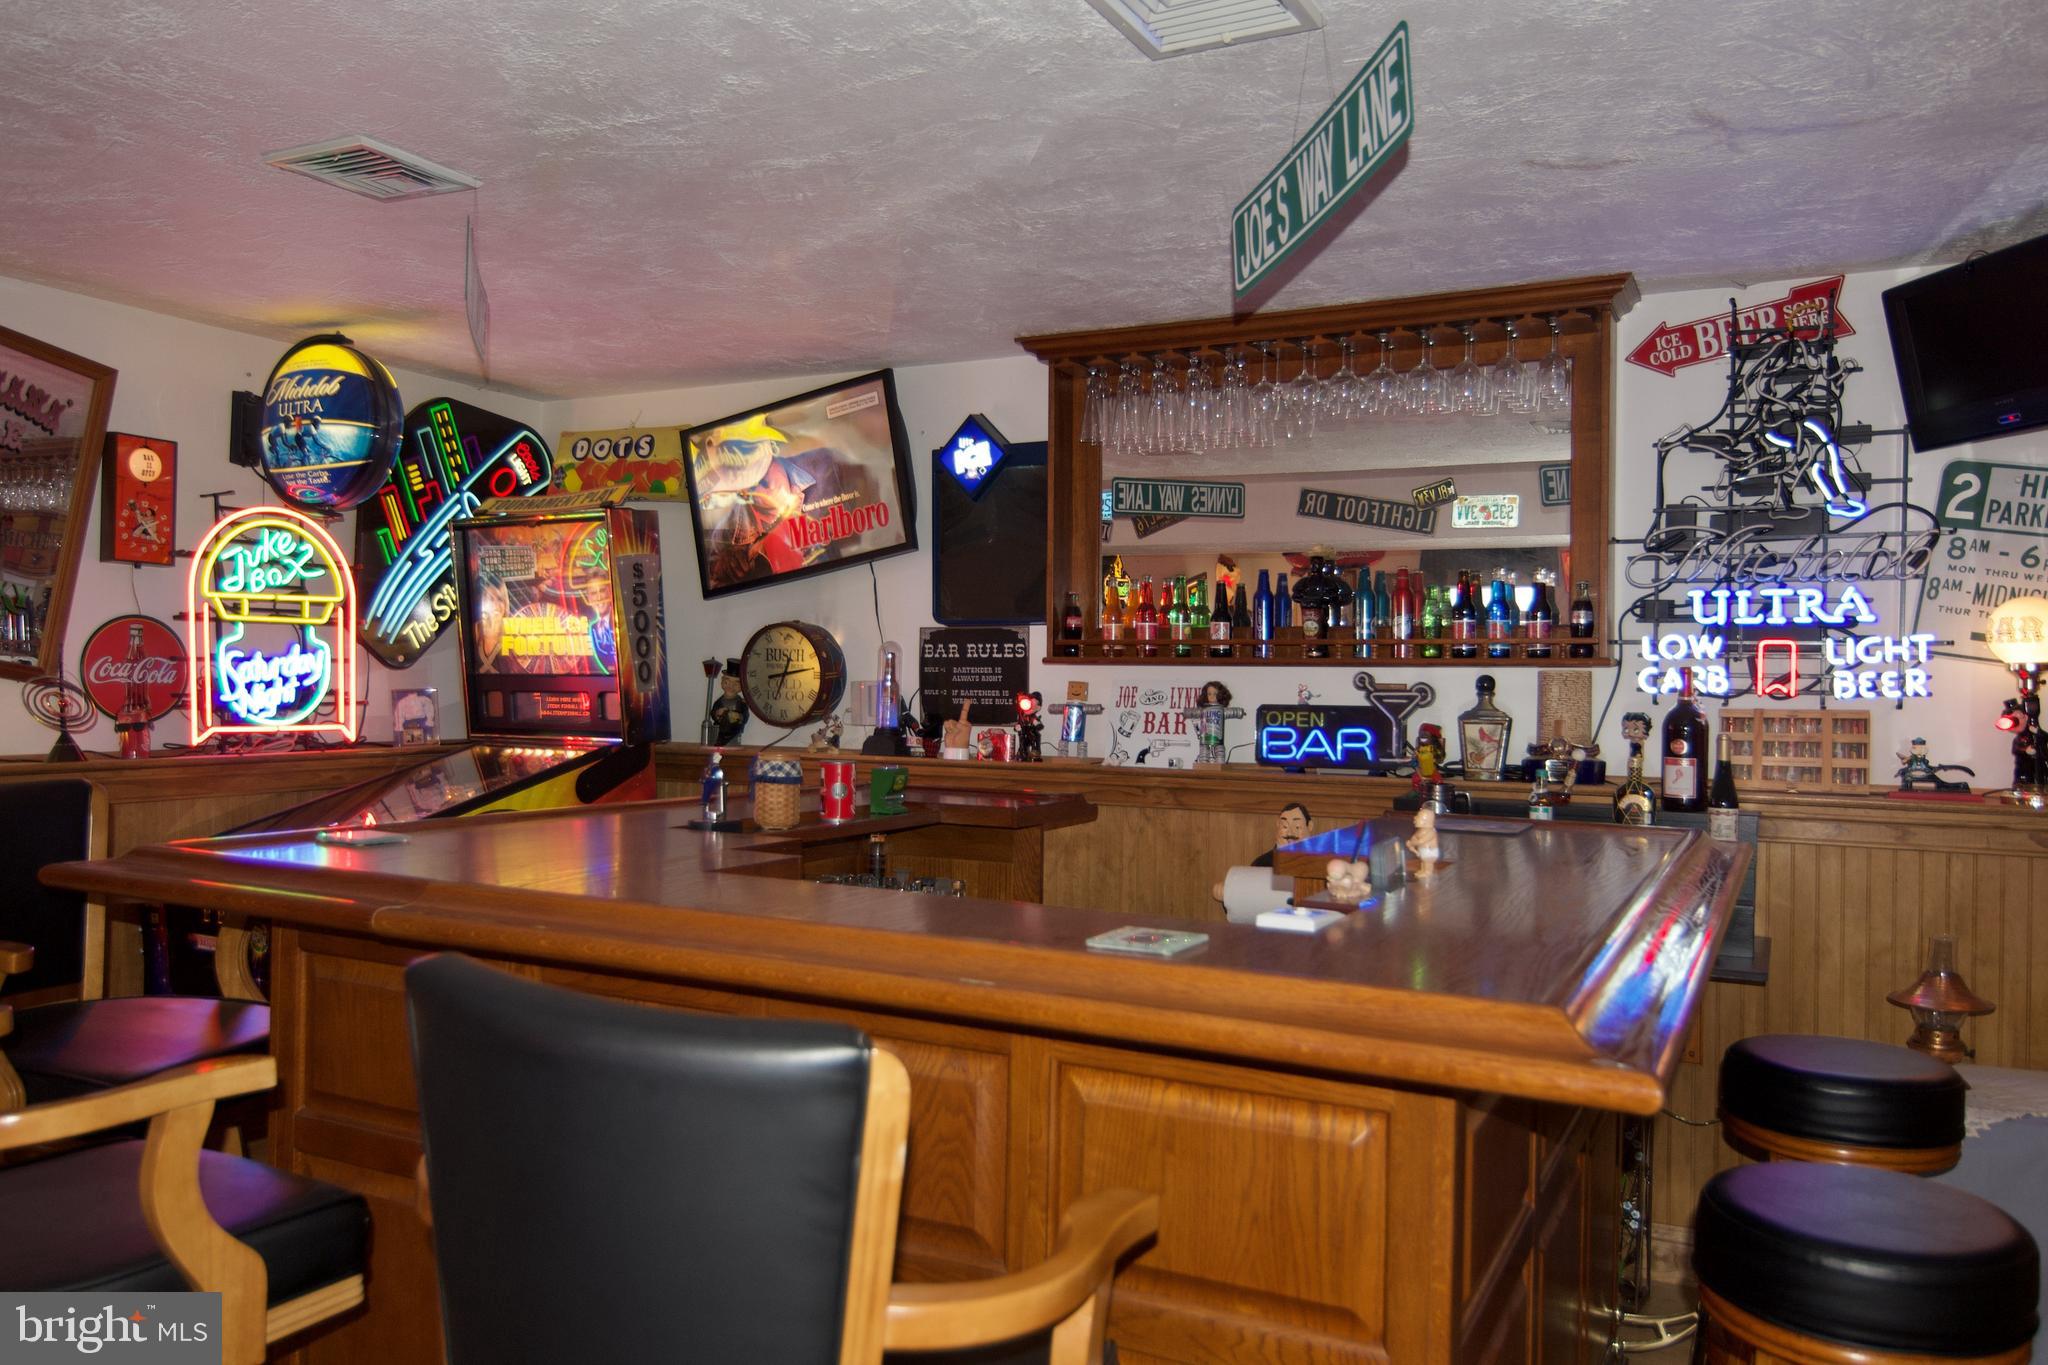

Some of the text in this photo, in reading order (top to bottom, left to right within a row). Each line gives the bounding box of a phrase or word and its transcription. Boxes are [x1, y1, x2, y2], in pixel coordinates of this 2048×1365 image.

[1296, 122, 1334, 225] WAY
[1342, 45, 1403, 181] LANE
[1783, 296, 1828, 319] SOLD
[1655, 332, 1683, 350] ICE
[1693, 306, 1785, 359] BEER
[1650, 344, 1693, 366] COLD
[266, 375, 347, 406] Michelob
[278, 399, 324, 417] ULTRA
[572, 434, 656, 461] DOTS
[1945, 473, 1982, 521] 2
[788, 502, 890, 550] Marlboro
[1625, 525, 1941, 590] Michelob
[1947, 564, 2048, 583] MON THRU WE
[1687, 586, 1877, 625] ULTRA
[1938, 605, 1971, 617] THUR
[402, 613, 440, 648] The
[503, 615, 566, 634] WHEEL
[501, 635, 593, 656] FORTUNE
[766, 648, 805, 662] BUSCH
[924, 643, 1026, 659] BAR RULES
[1640, 634, 1724, 661] LOW
[1825, 633, 1935, 664] LIGHT
[89, 656, 177, 684] Coca-Cola
[219, 643, 323, 701] Saturday
[1638, 666, 1730, 695] CARB
[784, 691, 805, 702] GO
[1116, 686, 1138, 708] JOE
[1145, 694, 1164, 703] AND
[1833, 670, 1933, 698] BEER
[1143, 711, 1187, 735] BAR
[1266, 711, 1325, 728] OPEN
[1261, 726, 1373, 762] BAR
